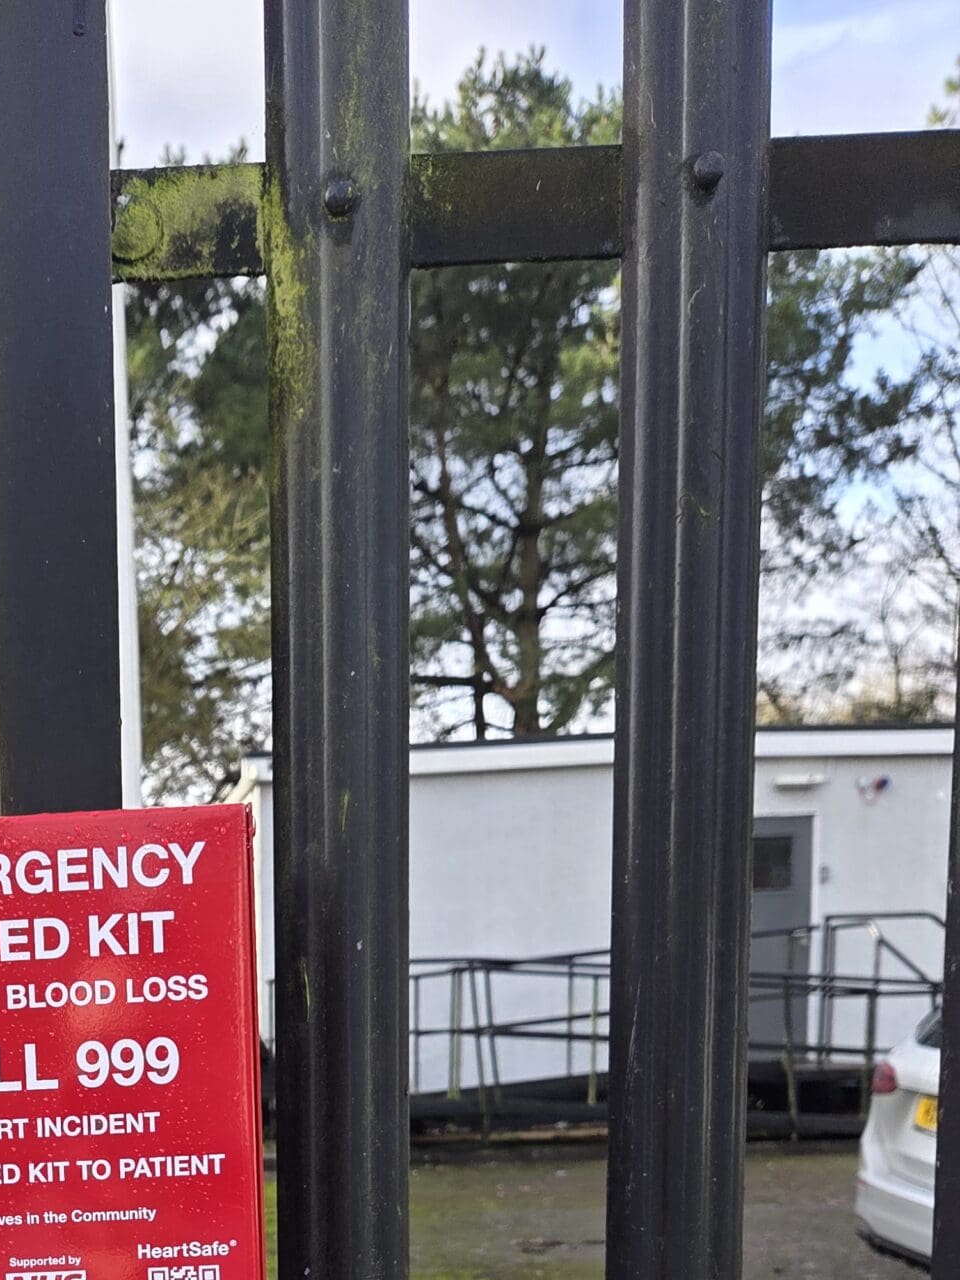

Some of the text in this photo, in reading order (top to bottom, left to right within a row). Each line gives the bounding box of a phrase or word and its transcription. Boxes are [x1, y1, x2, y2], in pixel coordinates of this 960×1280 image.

[89, 911, 174, 957] KIT
[7, 980, 116, 1009] BLOOD
[126, 974, 208, 1003] LOSS
[76, 1037, 179, 1088] 999
[37, 1112, 160, 1137] INCIDENT
[29, 1161, 69, 1183] KIT
[76, 1160, 111, 1180] TO
[120, 1154, 225, 1178] PATIENT
[26, 1211, 40, 1225] in
[42, 1210, 68, 1224] the
[70, 1206, 157, 1223] Community
[9, 1255, 82, 1269] Supported by
